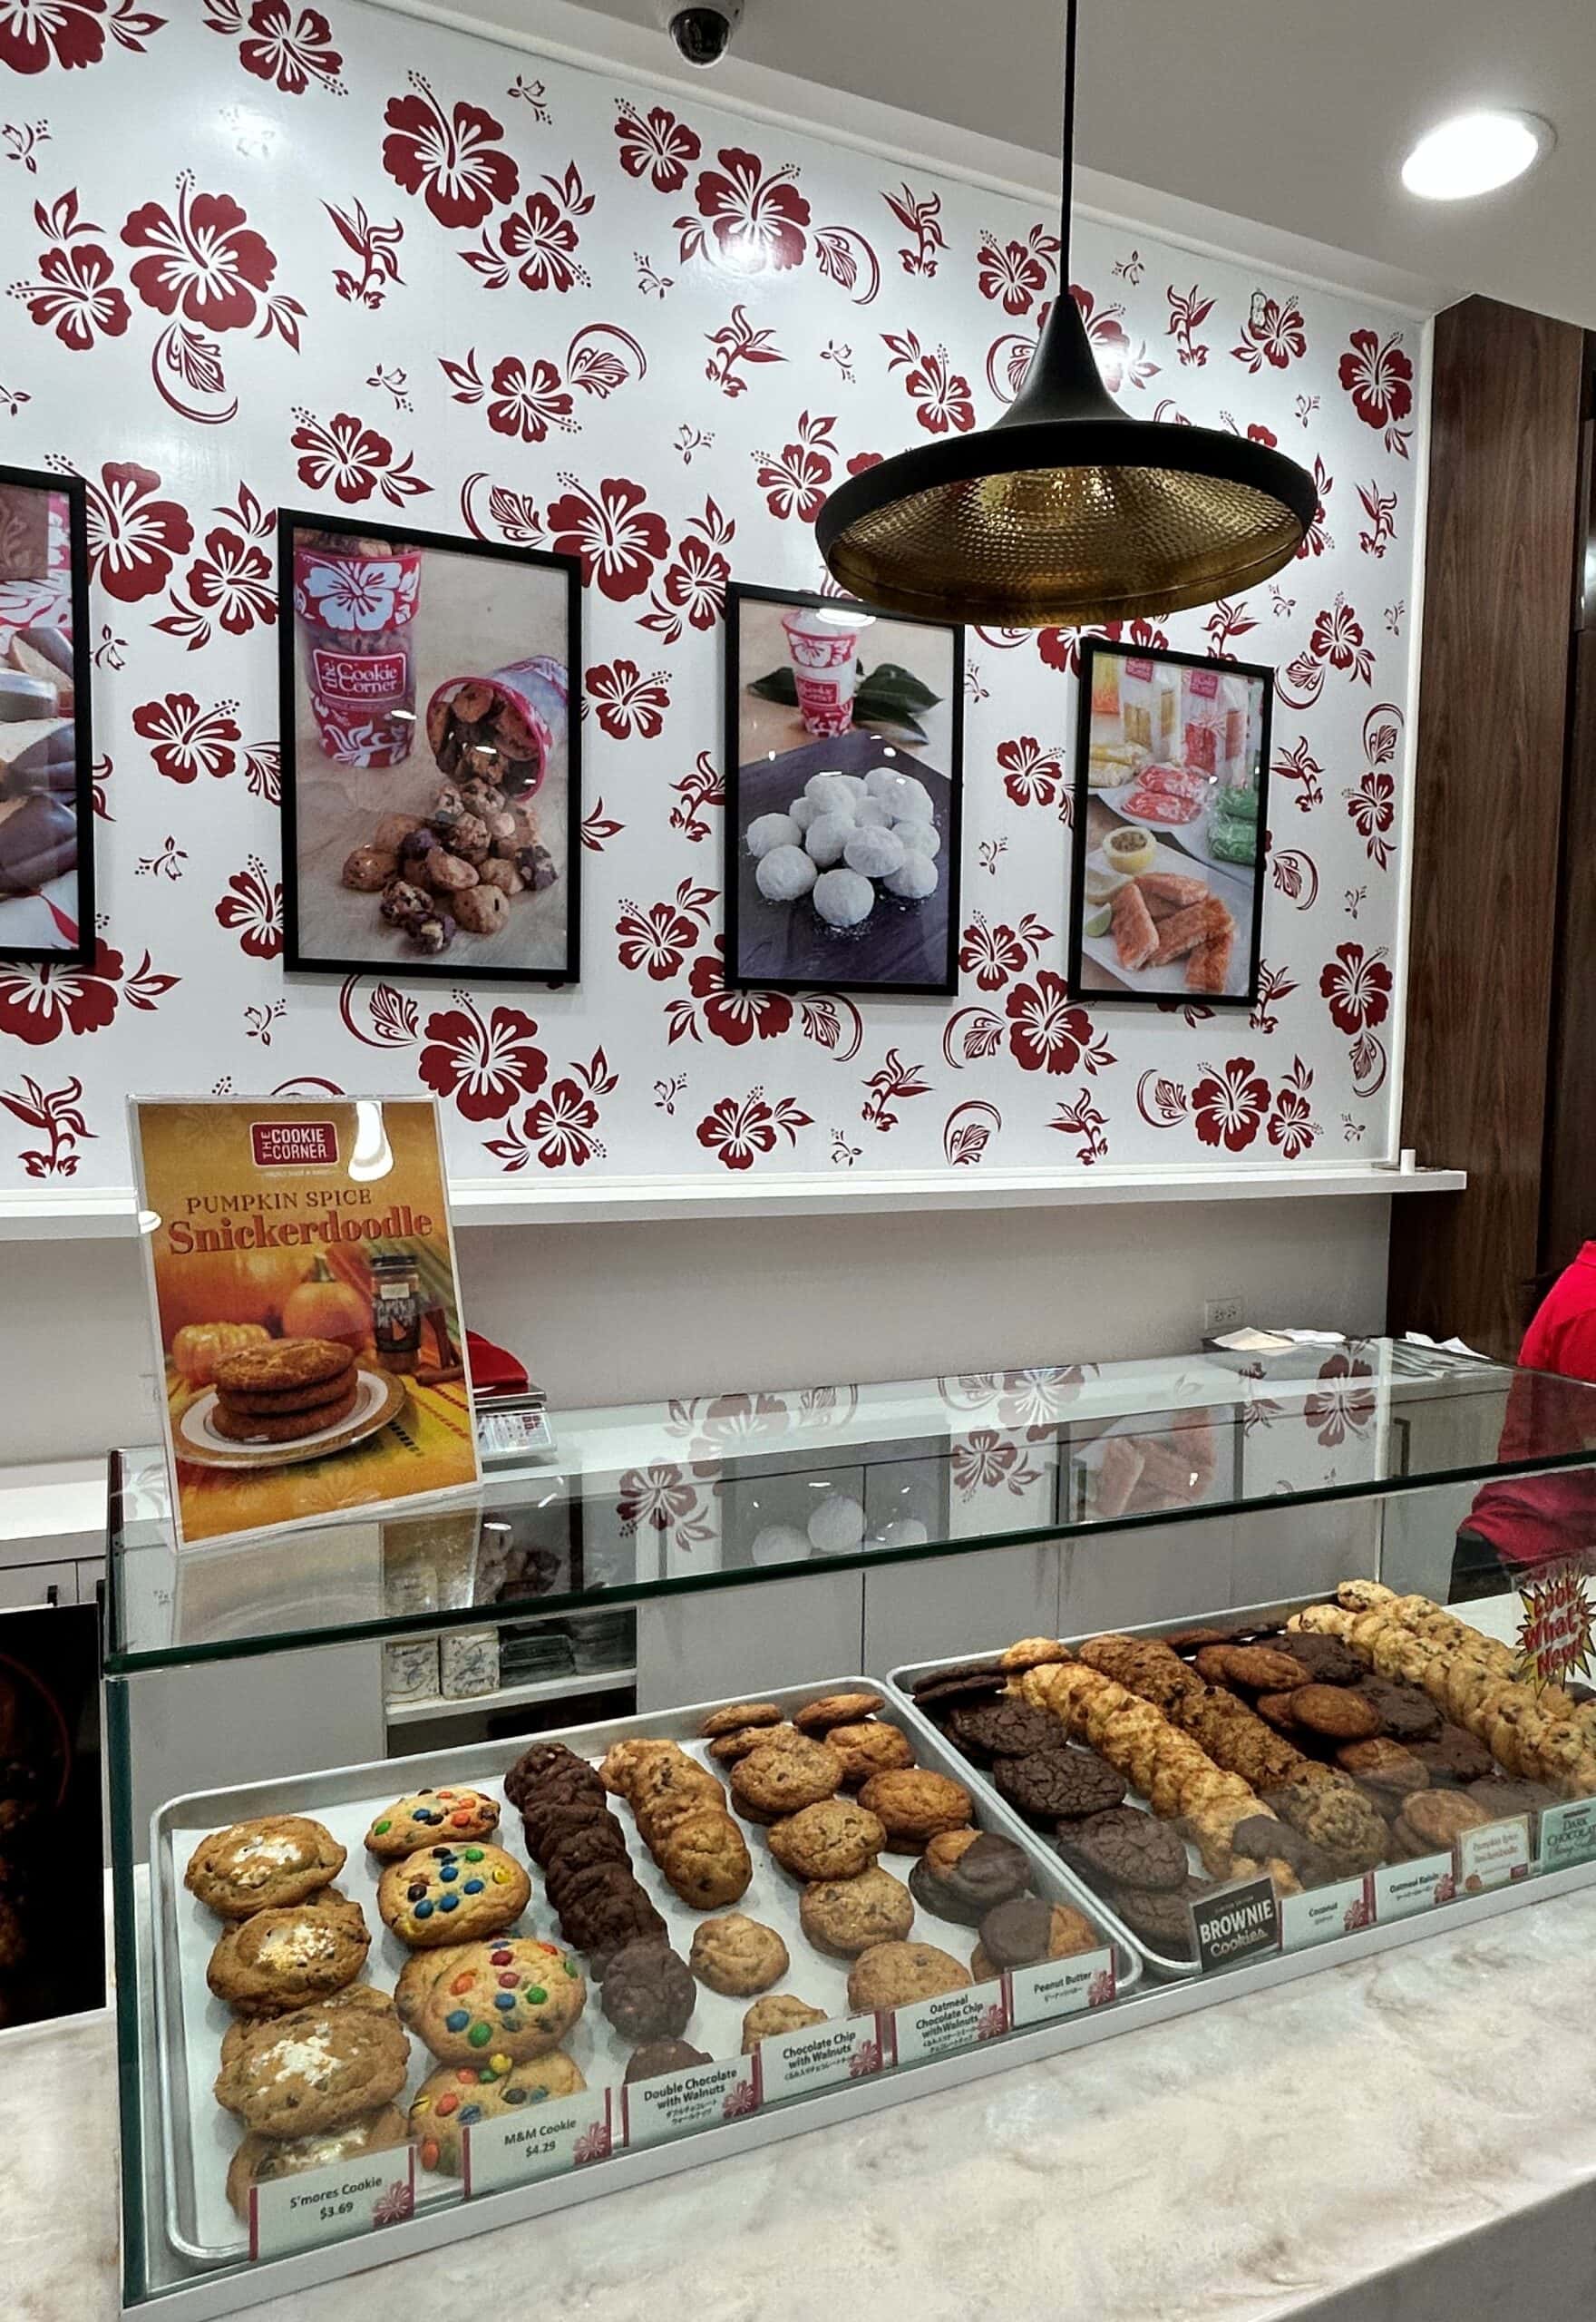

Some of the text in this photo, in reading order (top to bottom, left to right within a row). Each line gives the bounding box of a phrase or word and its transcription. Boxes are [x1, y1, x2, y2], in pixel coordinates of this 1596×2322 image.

[336, 662, 398, 680] Cookie
[338, 676, 398, 693] Corner
[260, 1131, 272, 1159] THE
[271, 1128, 325, 1144] COOKIE
[272, 1143, 327, 1160] CORNER
[187, 1189, 372, 1215] PUMPKIN SPICE
[168, 1205, 433, 1254] Snickerdoodle
[1562, 1818, 1588, 1832] DARK
[1200, 1899, 1273, 1944] BROWNIE
[1034, 1972, 1092, 1994] Peanut Butter
[916, 2002, 984, 2030] Chocolate Chip
[930, 1994, 968, 2015] Oatmeal
[921, 2024, 942, 2039] with
[942, 2015, 978, 2032] Walnuts
[783, 2031, 856, 2059] Chocolate Chip
[789, 2044, 852, 2070] with Walnuts
[644, 2069, 737, 2102] Double Chocolate
[657, 2084, 725, 2110] with Walnuts
[504, 2118, 577, 2146] M&M Cookie
[525, 2141, 556, 2158] $4.29
[290, 2177, 383, 2209] S'mores Cookie
[320, 2201, 354, 2220] $3.69
